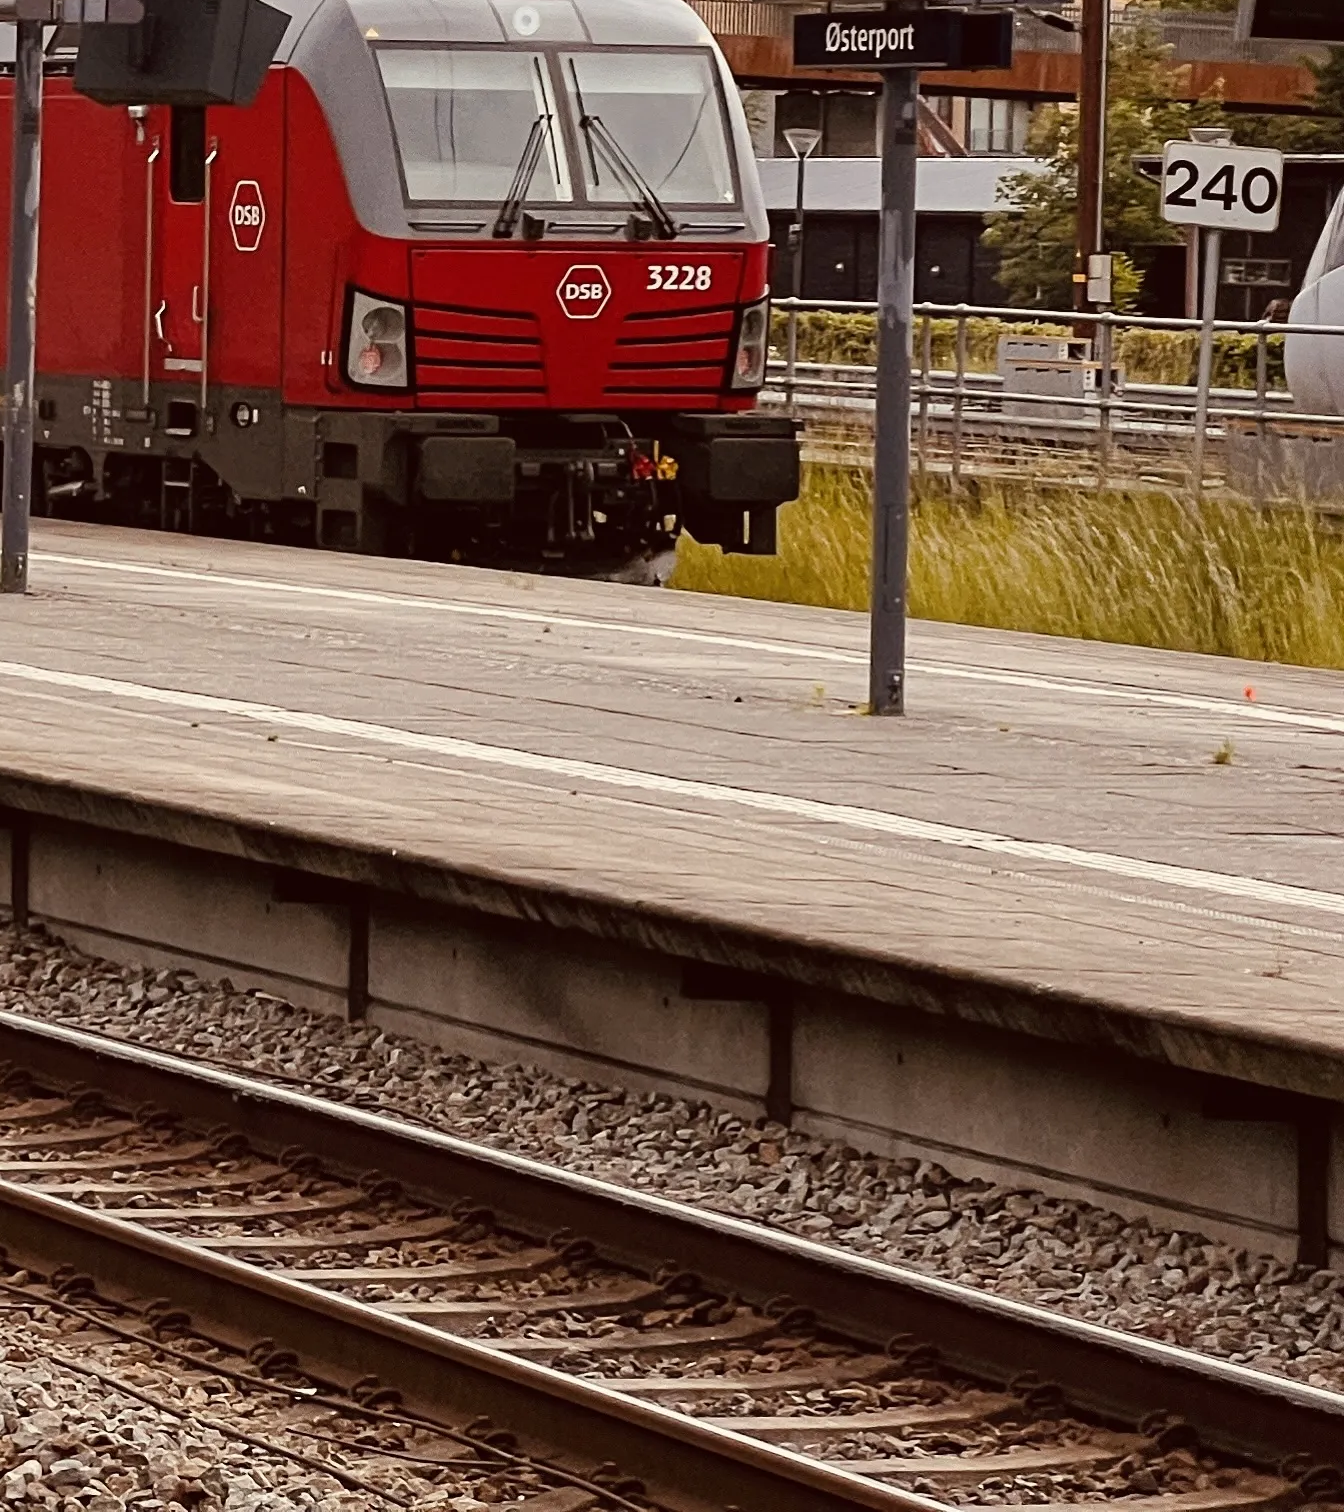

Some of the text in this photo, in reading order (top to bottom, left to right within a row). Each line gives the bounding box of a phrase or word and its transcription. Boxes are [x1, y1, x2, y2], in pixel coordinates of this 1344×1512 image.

[825, 22, 915, 58] Østerport
[1165, 159, 1278, 214] 240
[235, 205, 260, 225] DSB
[646, 265, 712, 290] 3228
[565, 283, 603, 300] DSB
